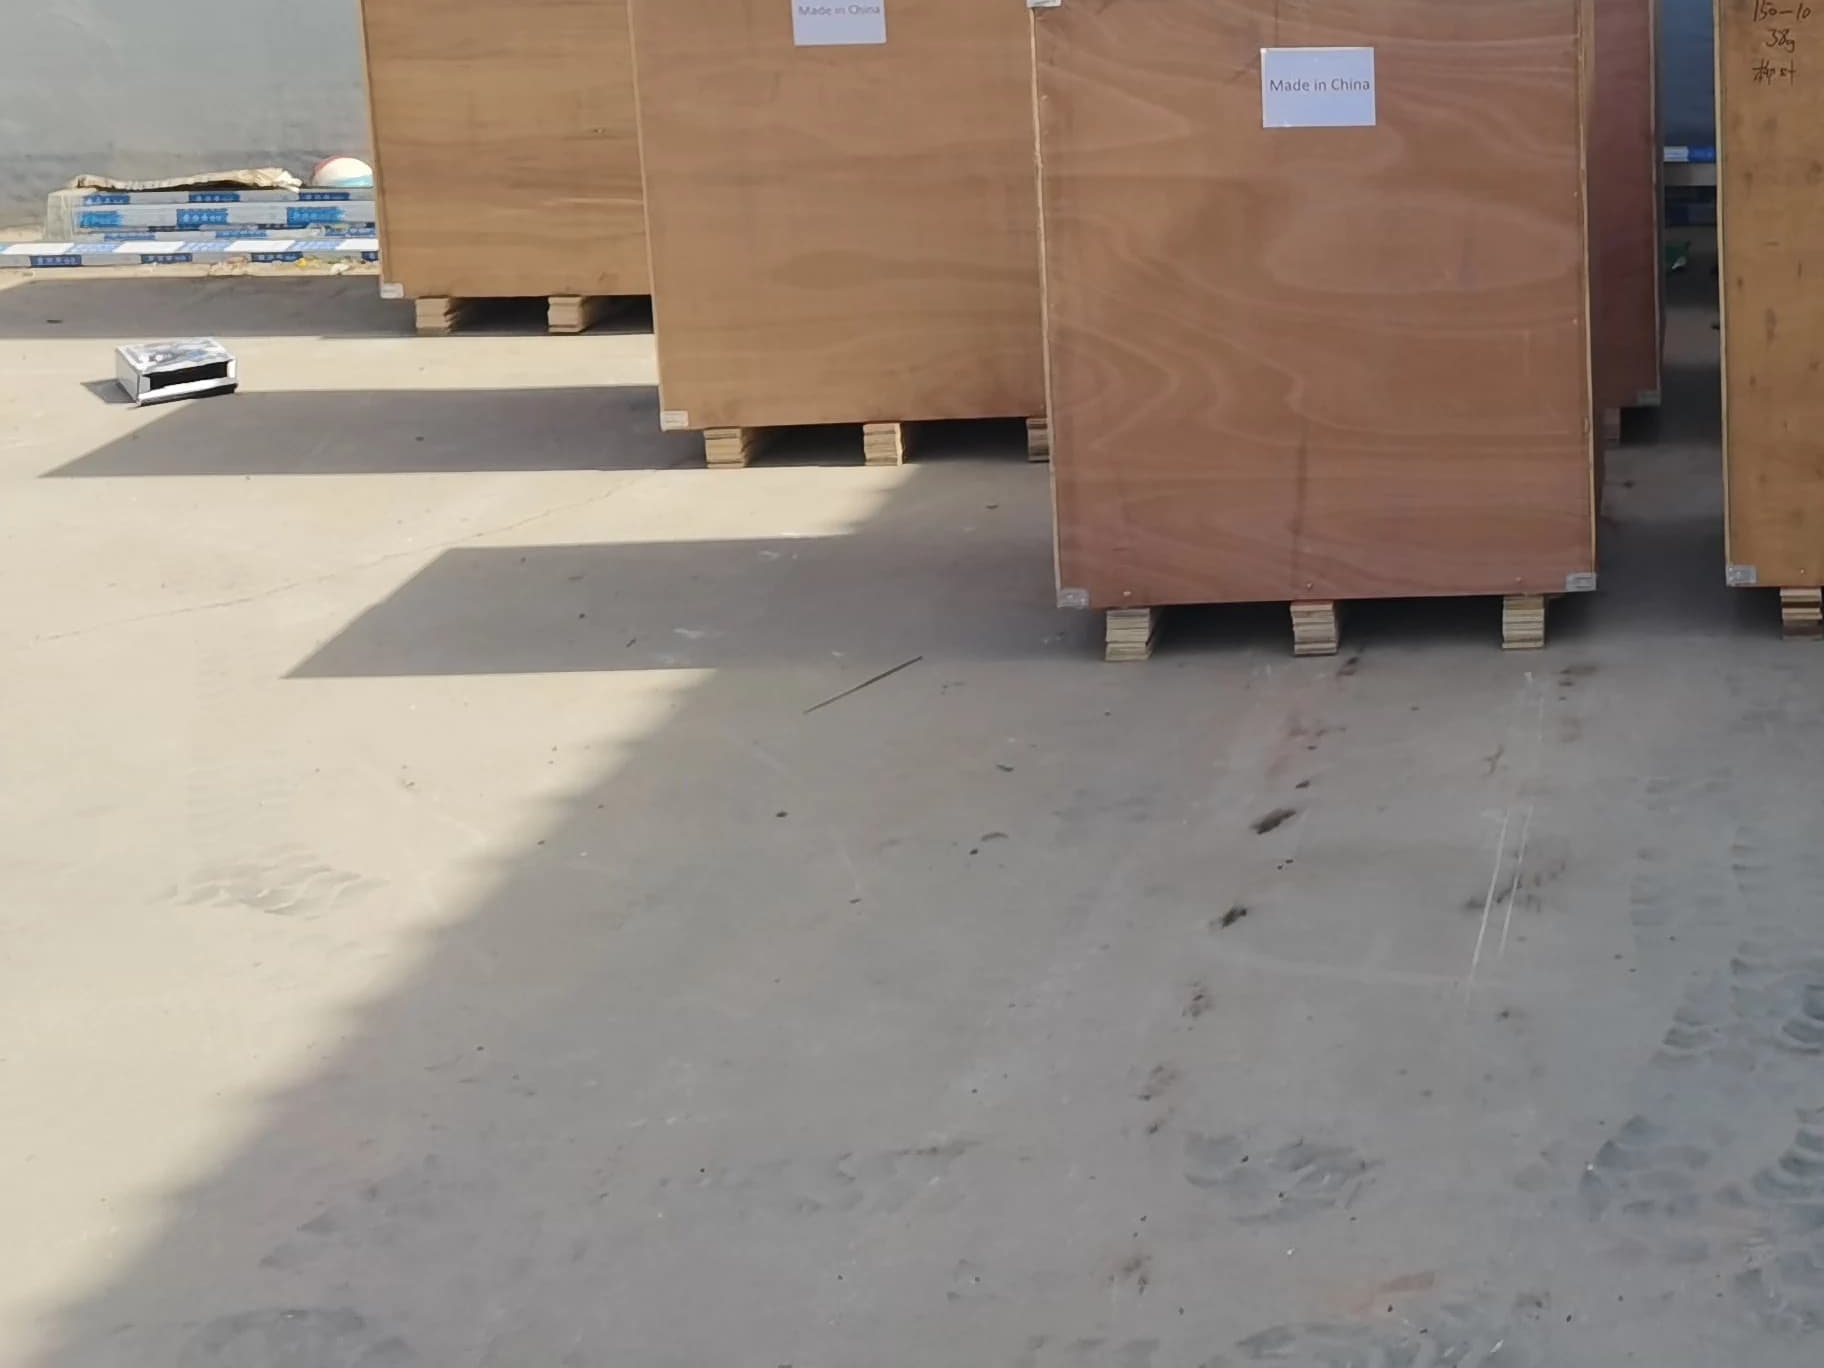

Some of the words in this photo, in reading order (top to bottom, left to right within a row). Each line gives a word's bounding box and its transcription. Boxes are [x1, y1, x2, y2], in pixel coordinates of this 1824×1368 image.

[799, 5, 833, 16] Made
[834, 4, 846, 15] in
[848, 3, 881, 15] China
[1269, 79, 1310, 92] Made
[1314, 79, 1326, 91] in
[1331, 78, 1370, 91] China
